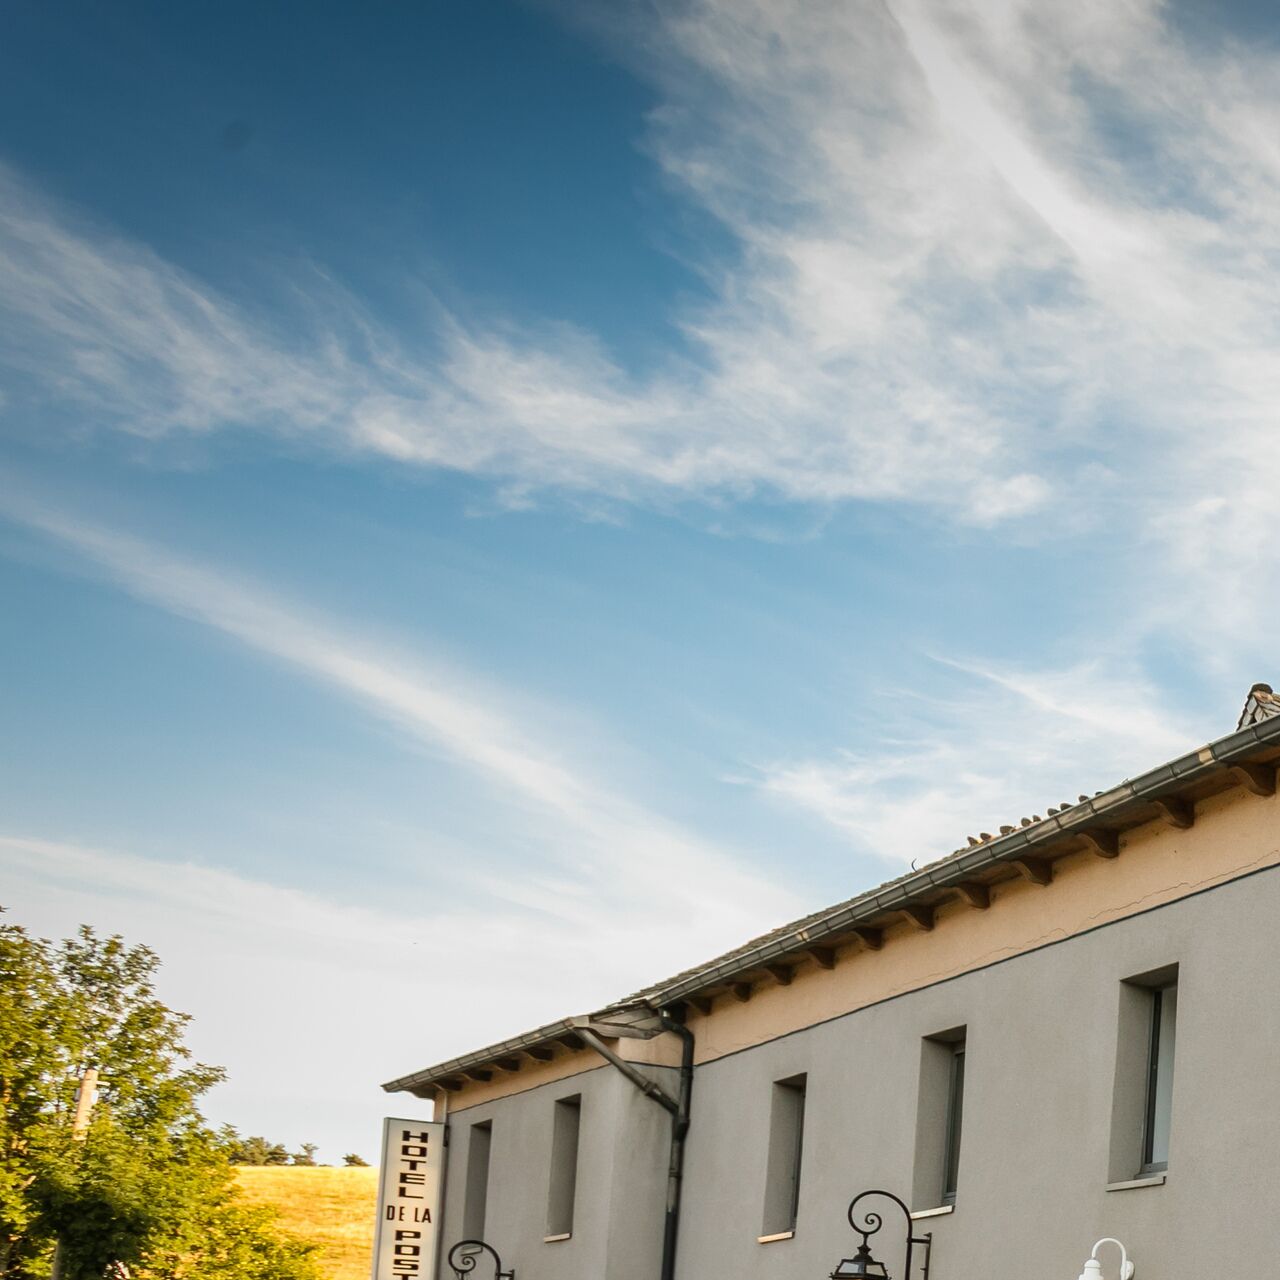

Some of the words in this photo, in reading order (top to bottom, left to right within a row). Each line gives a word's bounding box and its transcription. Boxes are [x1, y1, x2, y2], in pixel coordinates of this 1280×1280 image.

[398, 1130, 429, 1199] HOTEL
[386, 1205, 405, 1221] DE
[414, 1208, 432, 1223] LA
